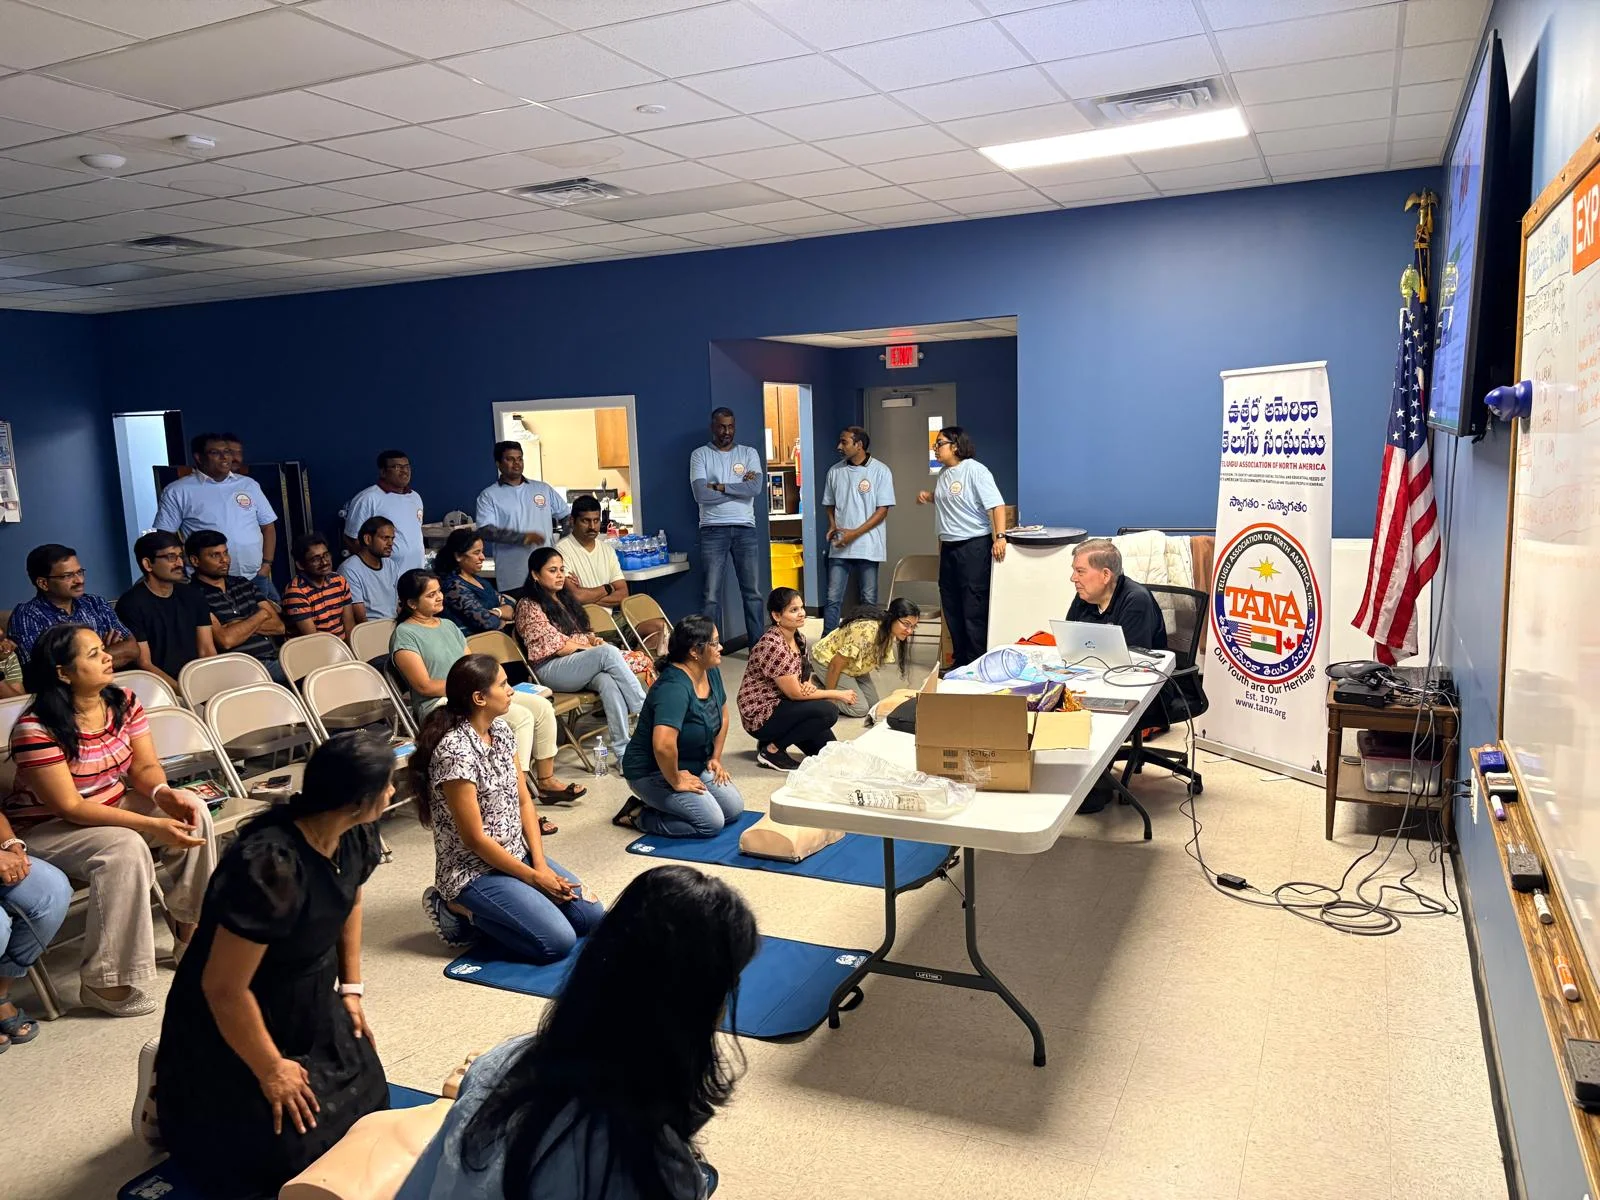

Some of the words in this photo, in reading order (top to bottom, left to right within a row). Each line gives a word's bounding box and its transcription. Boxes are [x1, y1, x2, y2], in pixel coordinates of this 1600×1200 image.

[1265, 396, 1318, 422] అమెరికా
[1239, 461, 1272, 469] ASSOCIATION
[1279, 462, 1298, 470] NORTH
[1299, 463, 1326, 471] AMERICA
[1229, 496, 1259, 511] స్వాగతం
[1218, 561, 1231, 592] TELUGU
[1229, 533, 1263, 564] ASSOCIATION
[1264, 533, 1273, 541] OF
[1272, 535, 1291, 554] NORTH
[1225, 584, 1306, 630] TANA
[1213, 647, 1228, 665] Our
[1228, 663, 1249, 687] Youth
[1251, 682, 1265, 693] are
[1267, 683, 1282, 694] Our
[1283, 664, 1316, 693] Heritage
[1235, 698, 1286, 720] www.tana.org
[1245, 690, 1258, 702] Est.
[1260, 694, 1278, 706] 1977
